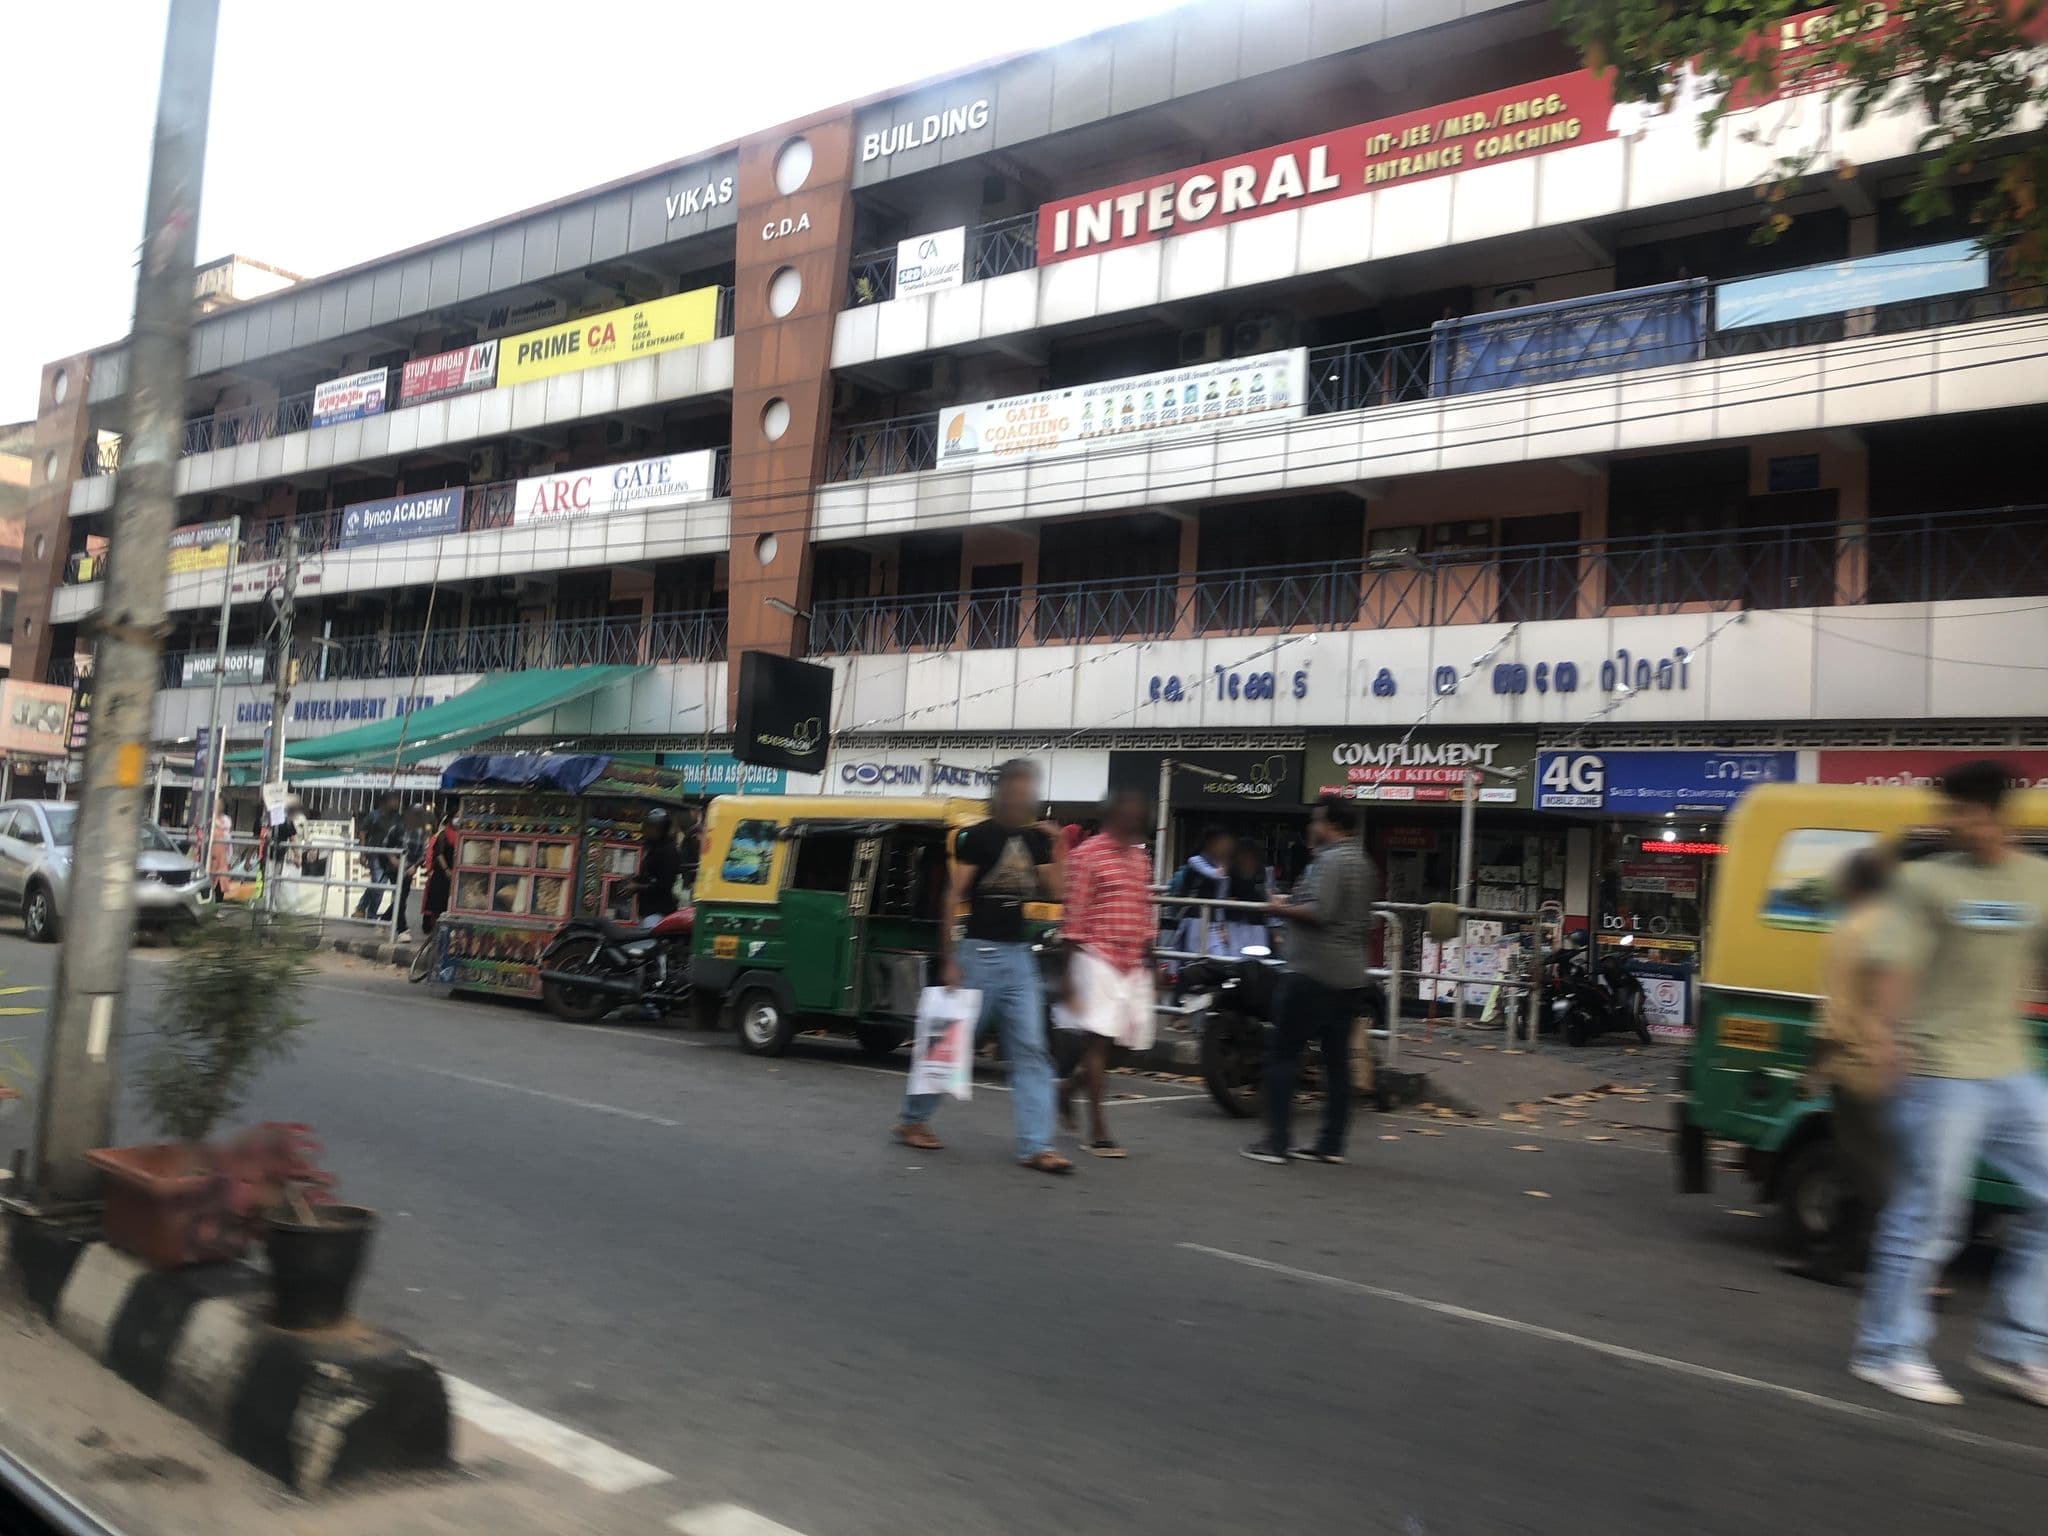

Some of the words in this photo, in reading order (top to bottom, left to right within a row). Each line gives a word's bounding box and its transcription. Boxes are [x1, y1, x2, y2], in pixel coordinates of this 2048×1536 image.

[862, 100, 989, 162] BUILDING
[1364, 144, 1464, 184] ENTRANCE
[1474, 118, 1582, 160] COACHING
[665, 176, 734, 220] VIKAS
[1054, 144, 1341, 254] INTEGRAL
[762, 213, 811, 241] C.D.A
[517, 330, 581, 365] PRIME
[587, 322, 616, 348] CA
[646, 332, 685, 349] ENTRANCE
[405, 361, 430, 379] STUDY
[431, 350, 464, 374] ABROAD
[985, 417, 1071, 443] COACHING
[614, 461, 671, 490] GATE
[531, 477, 592, 516] ARC
[363, 509, 392, 530] Bynco
[393, 496, 451, 522] ACADEMY
[194, 656, 219, 673] NORK
[224, 654, 253, 671] ROOTS
[237, 703, 275, 723] CALIC
[294, 698, 386, 721] DEVELOPMENT
[1332, 743, 1499, 766] COMPLIMENT
[842, 763, 921, 785] COCHIN
[932, 765, 969, 785] AKE
[1347, 767, 1401, 783] SMART
[1541, 755, 1604, 793] 4G
